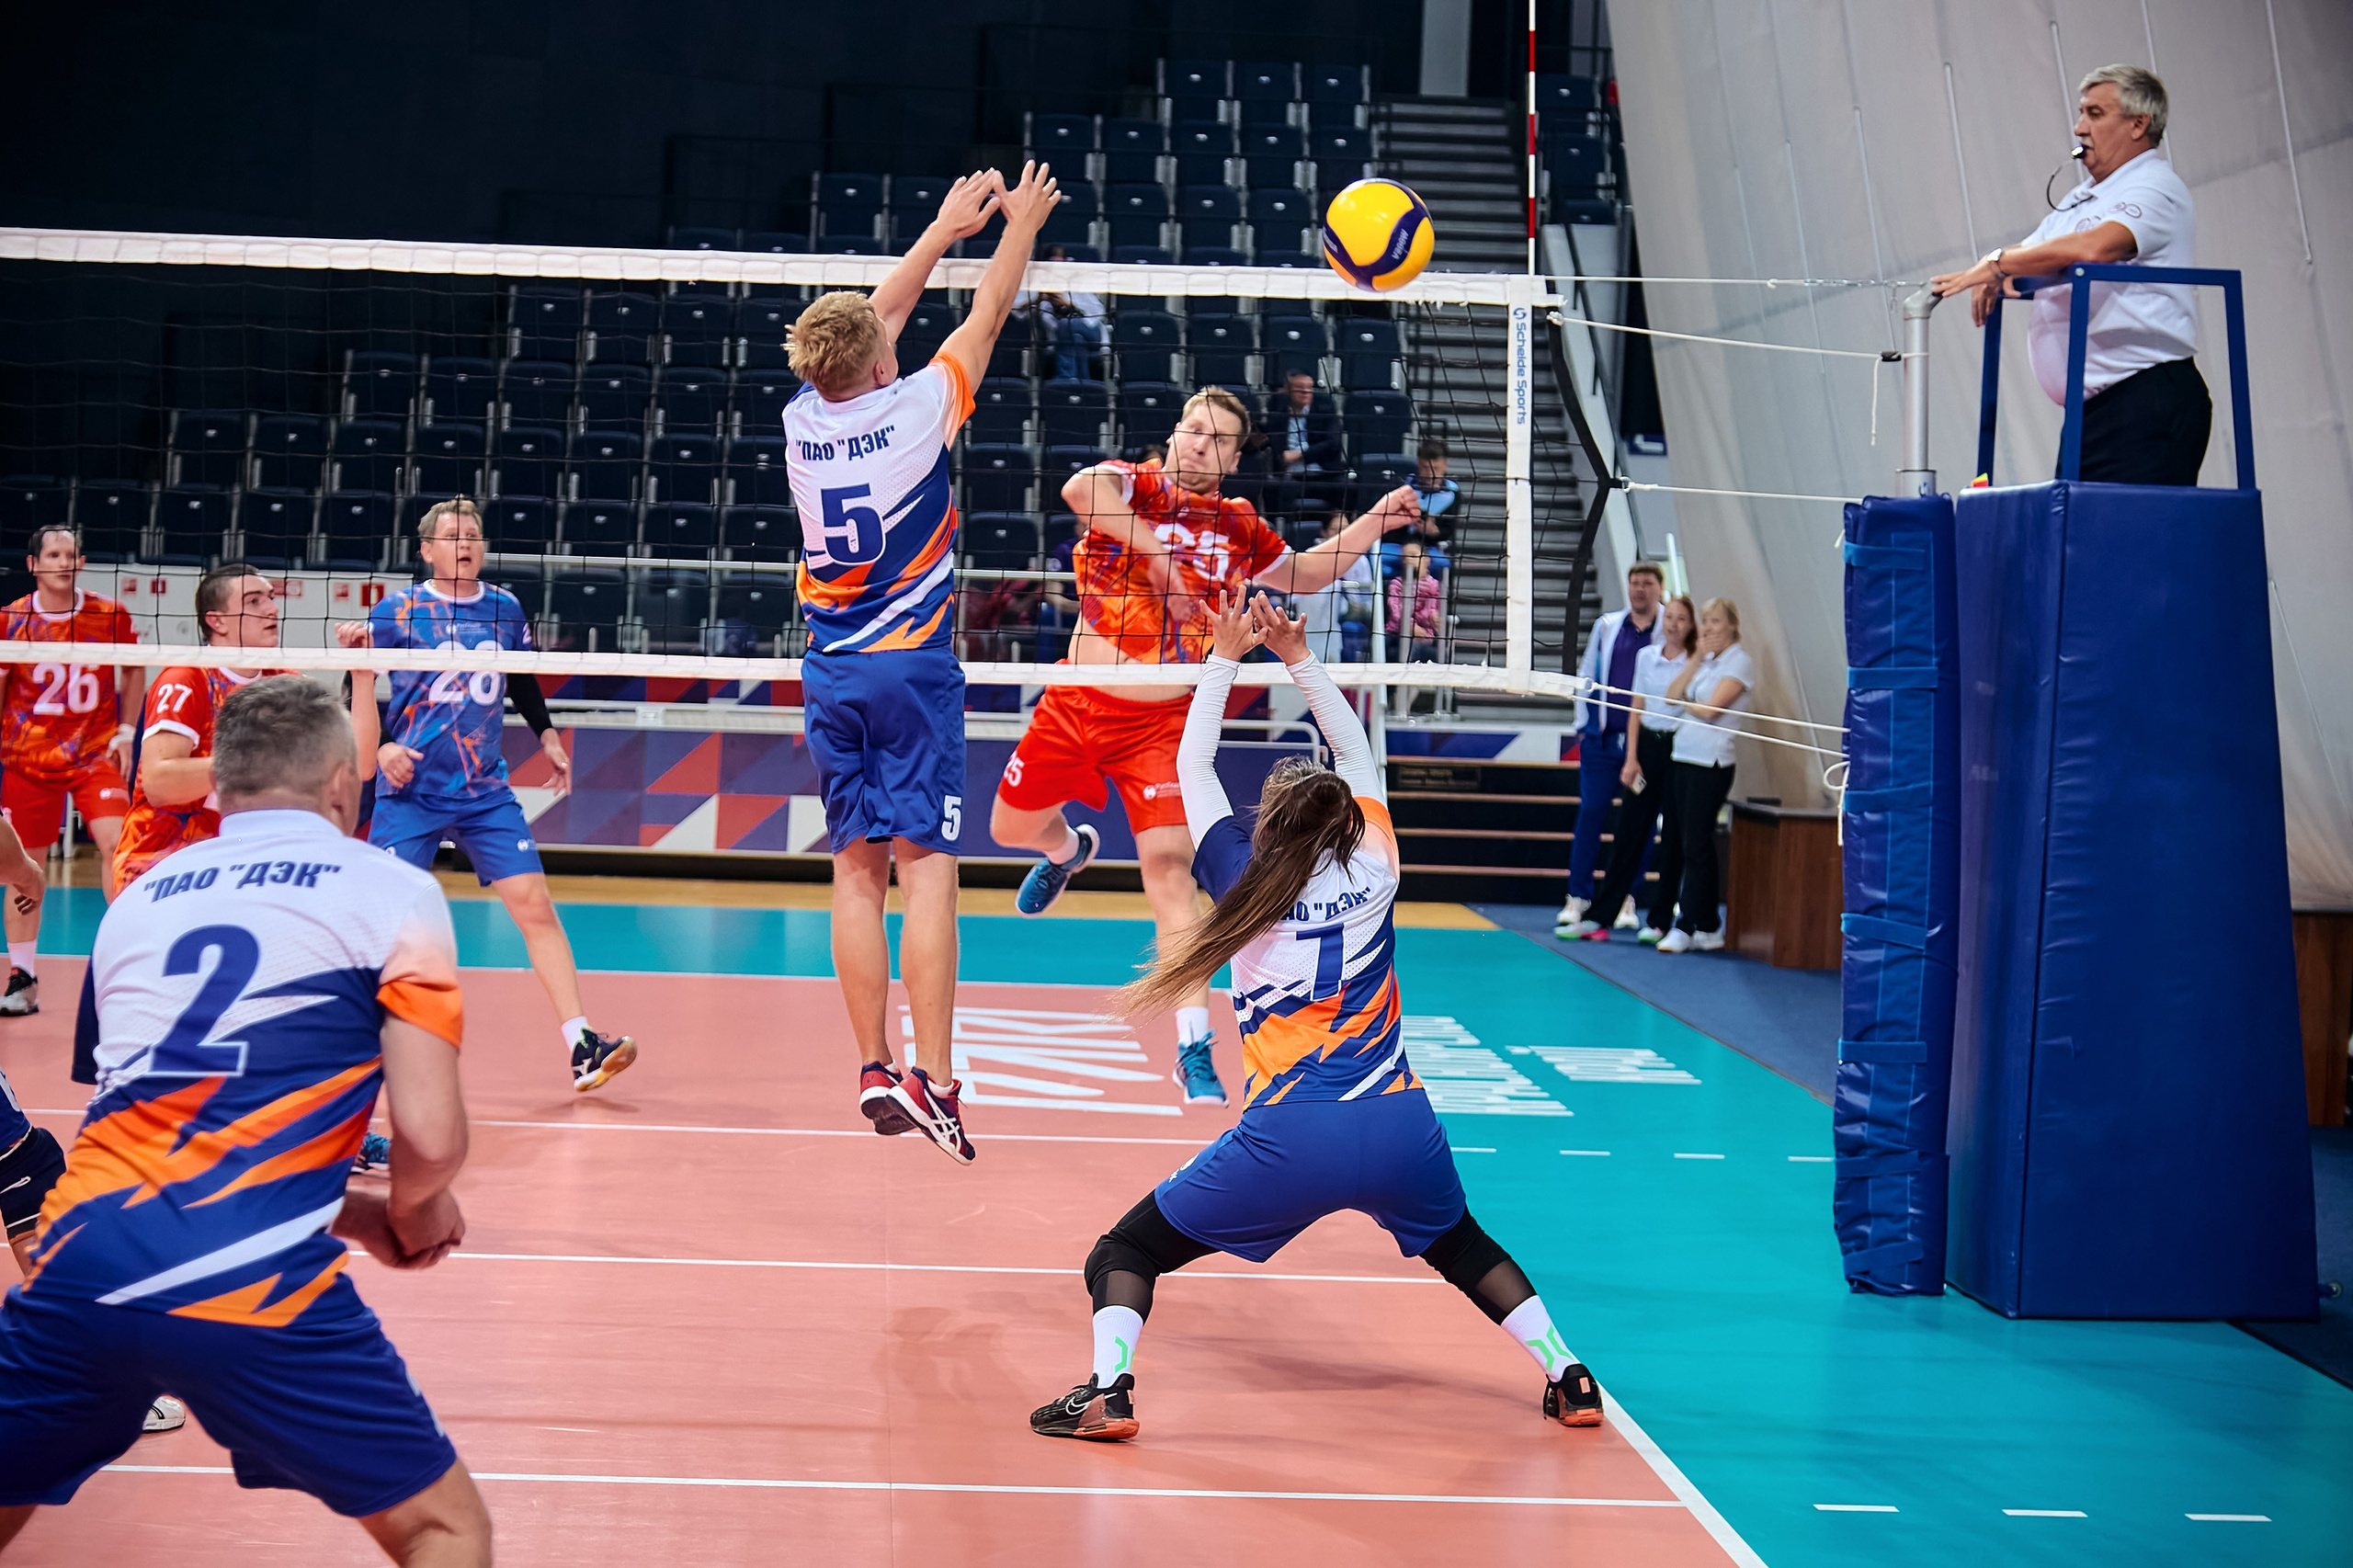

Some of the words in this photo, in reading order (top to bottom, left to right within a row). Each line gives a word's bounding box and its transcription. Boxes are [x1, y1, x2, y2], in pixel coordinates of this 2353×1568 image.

[1517, 322, 1528, 377] Schelde
[1515, 380, 1528, 425] Sports
[796, 438, 835, 460] "ПАО
[836, 425, 895, 460] "ДЭК"
[820, 482, 887, 566] 5
[31, 663, 99, 716] 26
[156, 683, 193, 714] 27
[941, 794, 961, 841] 5
[143, 867, 221, 903] "ПАО
[229, 860, 342, 889] "ДЭК"
[1295, 922, 1344, 1001] 7
[147, 924, 262, 1077] 2
